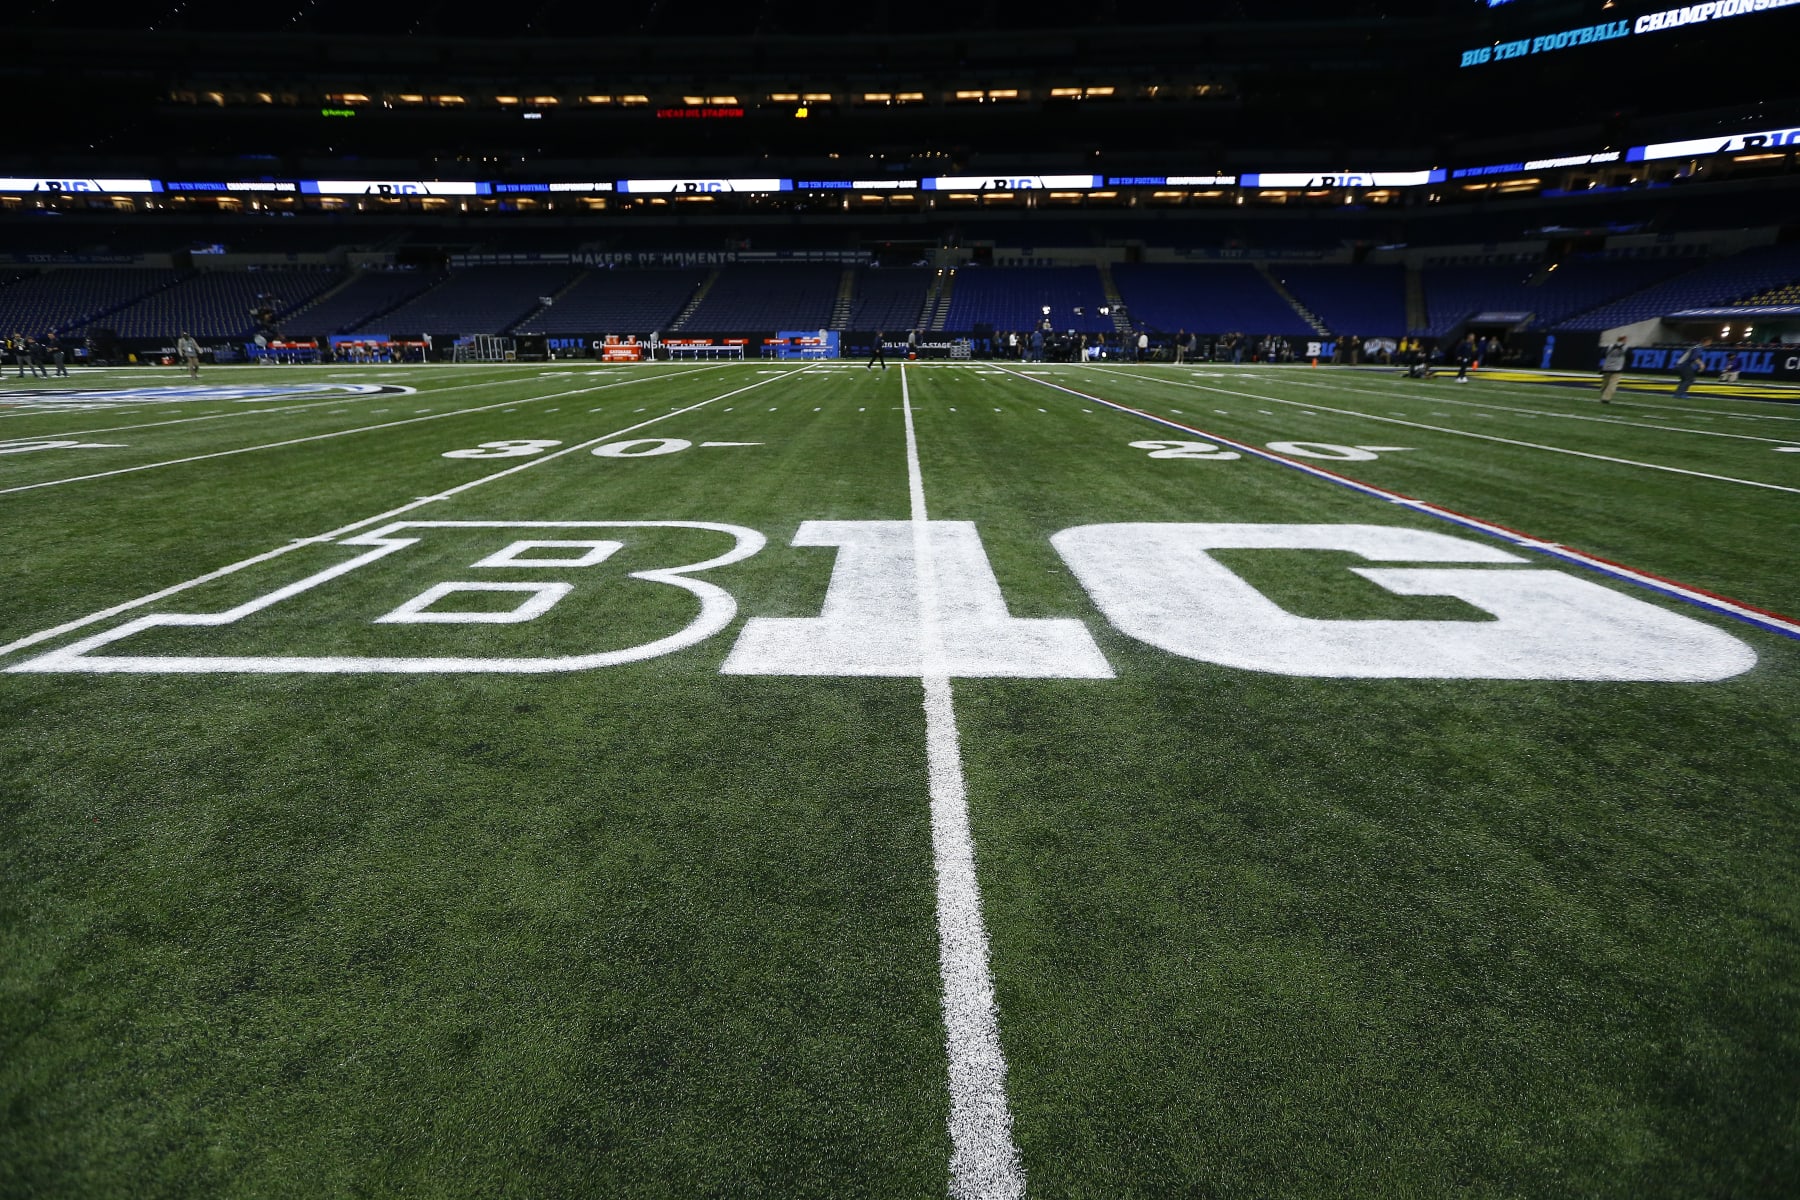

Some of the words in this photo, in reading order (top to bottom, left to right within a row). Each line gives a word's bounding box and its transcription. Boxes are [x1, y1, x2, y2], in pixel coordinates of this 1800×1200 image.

[1459, 46, 1491, 67] BIG
[1493, 39, 1531, 61] TEN
[1531, 19, 1630, 55] FOOTBALL
[656, 108, 684, 118] LUCAS
[685, 108, 700, 118] OIL
[701, 108, 744, 118] STADIUM
[1631, 349, 1668, 369] TEN
